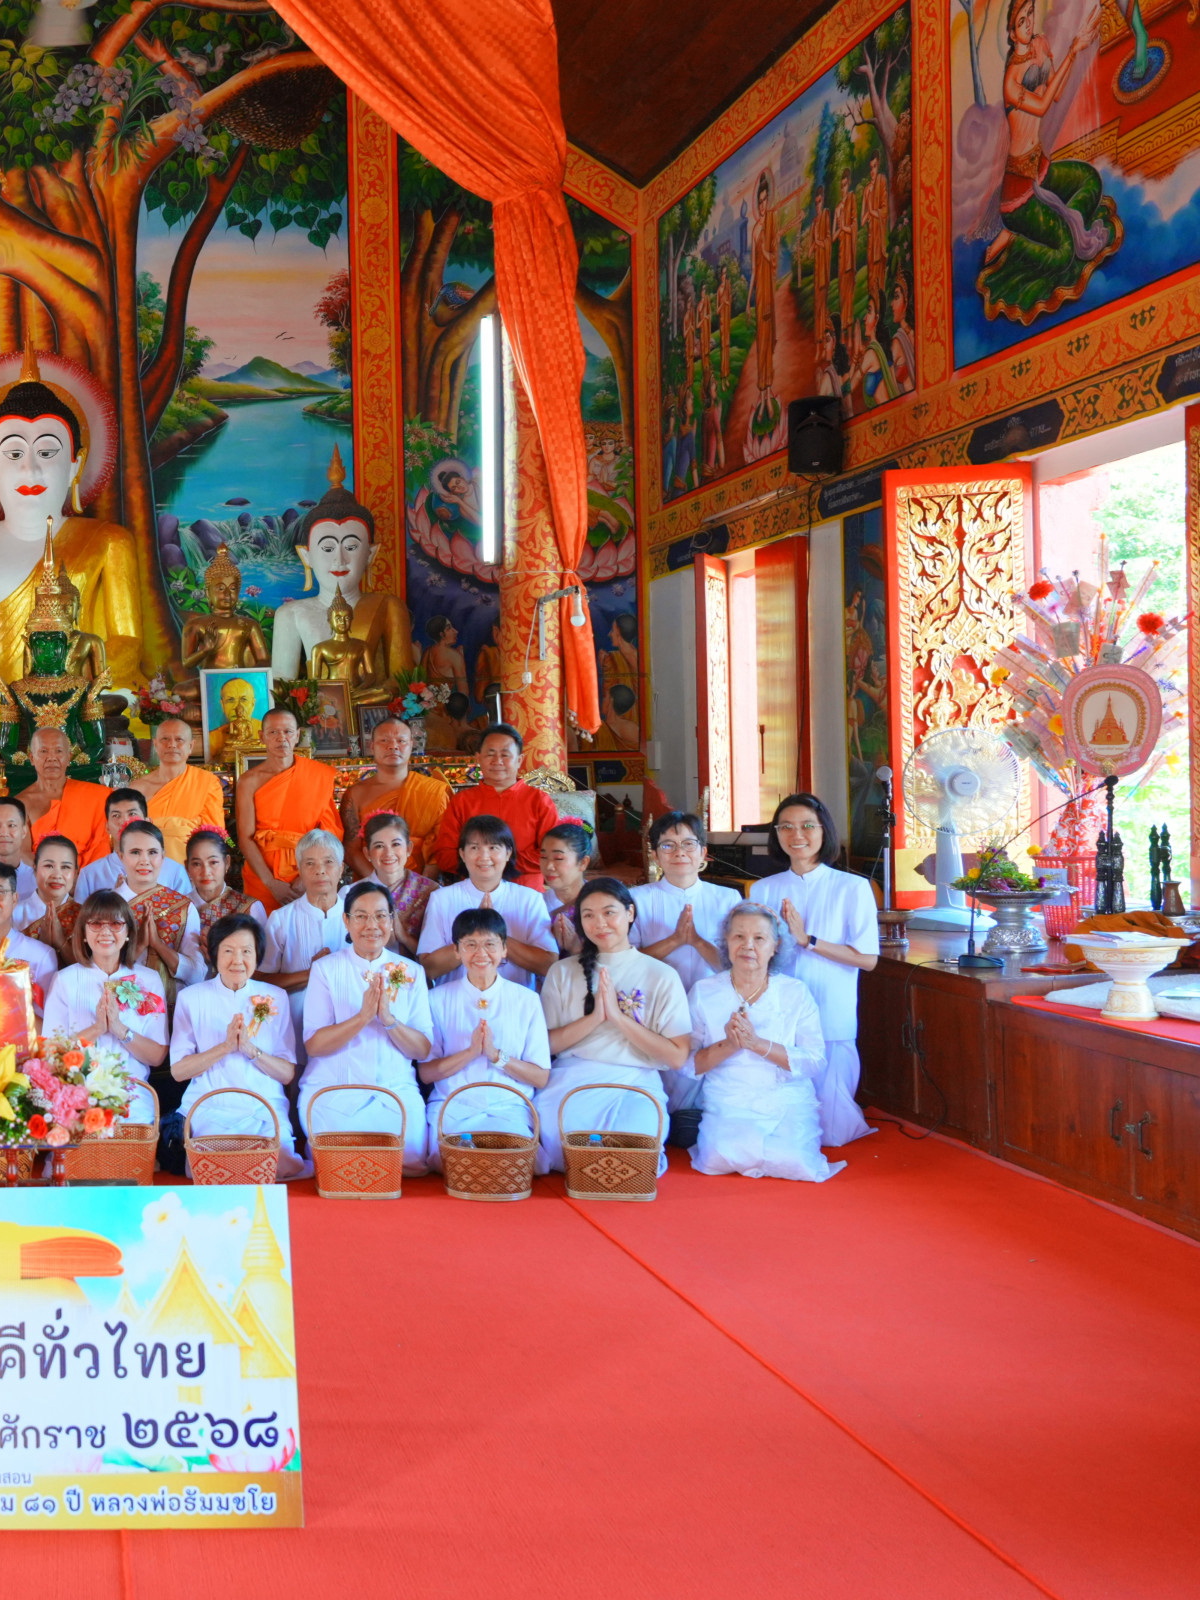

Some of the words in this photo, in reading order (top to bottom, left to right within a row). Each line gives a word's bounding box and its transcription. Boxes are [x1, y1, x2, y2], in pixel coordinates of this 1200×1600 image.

[122, 1410, 279, 1450] ๒๕๖๘
[24, 1497, 57, 1514] ๘๑
[66, 1489, 81, 1512] ปี
[91, 1487, 275, 1512] หลวงพ่อธัมมชโย
